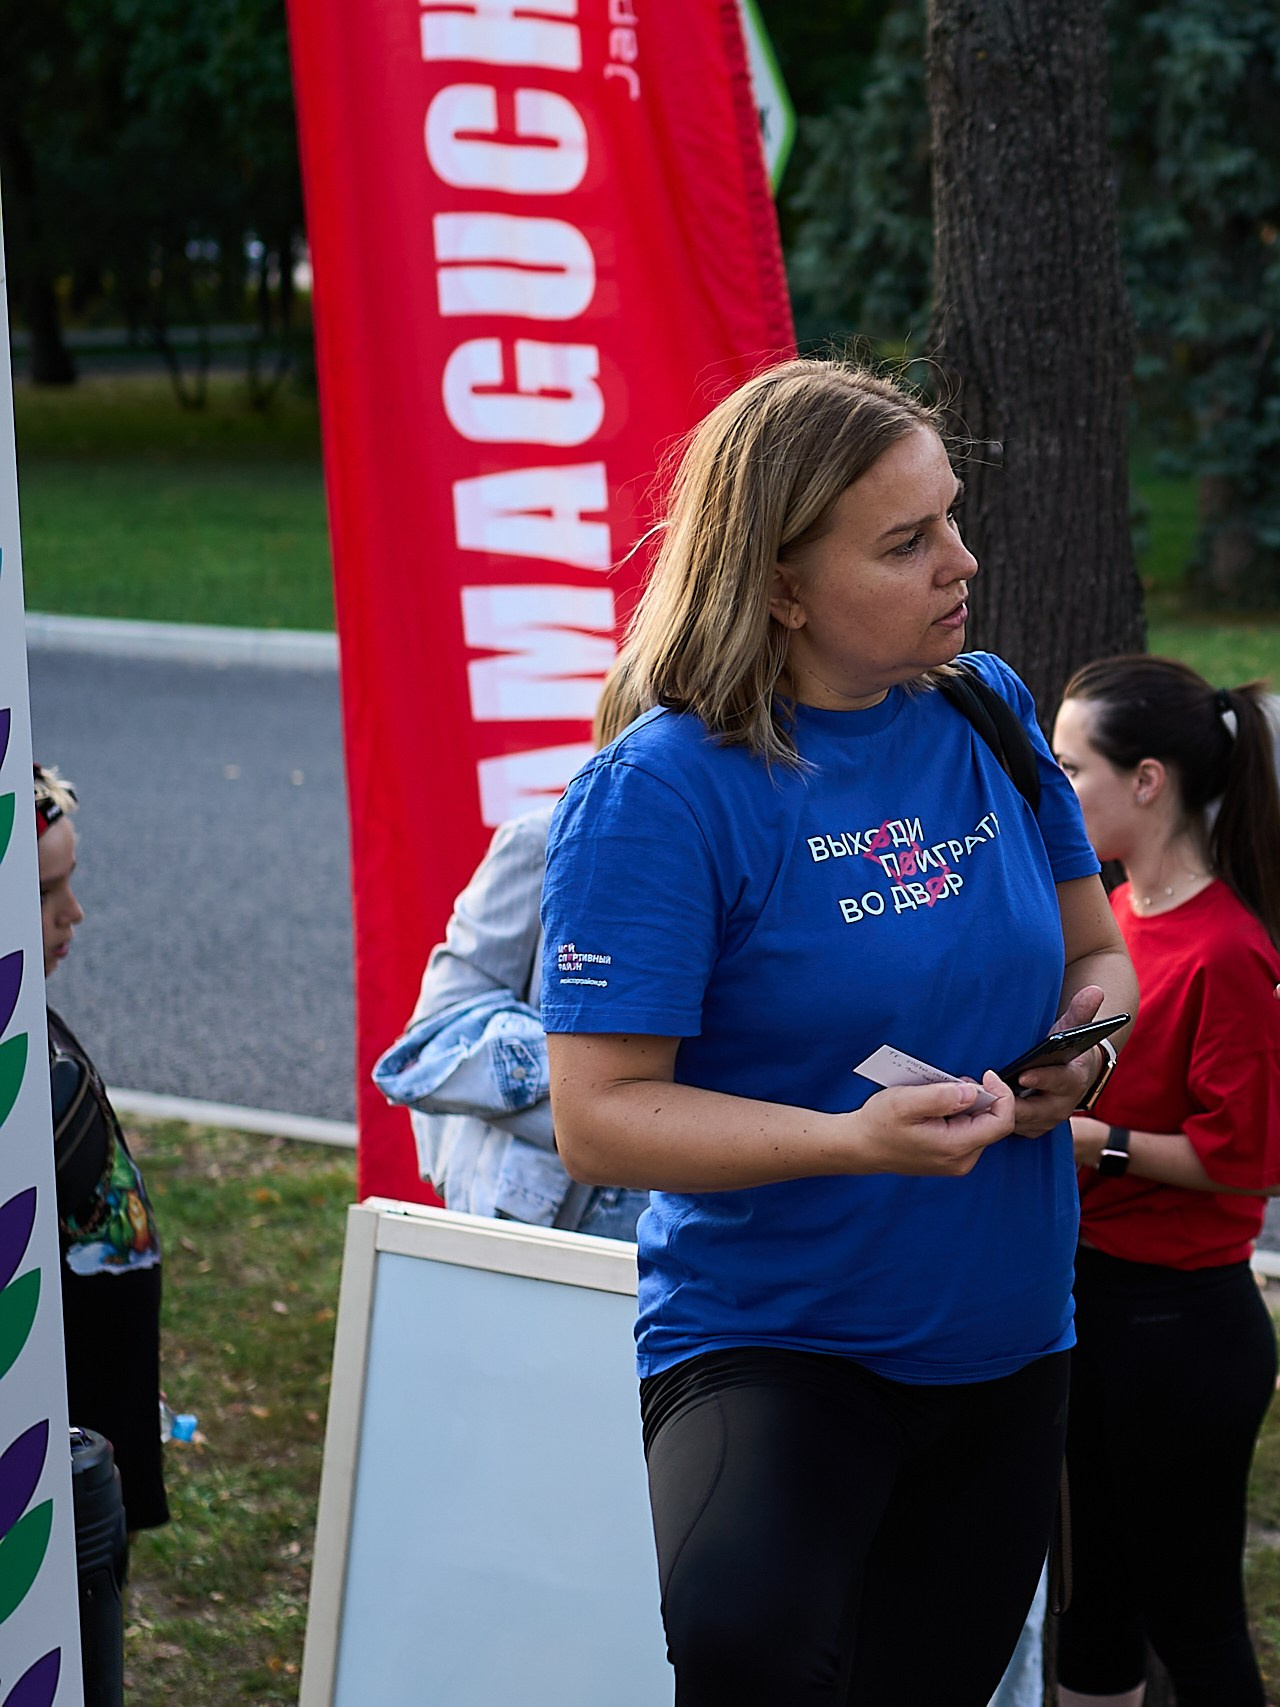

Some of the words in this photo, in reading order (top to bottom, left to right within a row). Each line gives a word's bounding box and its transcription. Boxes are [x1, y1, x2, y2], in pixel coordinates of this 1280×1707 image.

[807, 817, 924, 862] ВЫХОДИ
[838, 891, 885, 923] ВО
[890, 873, 963, 914] ДВОР
